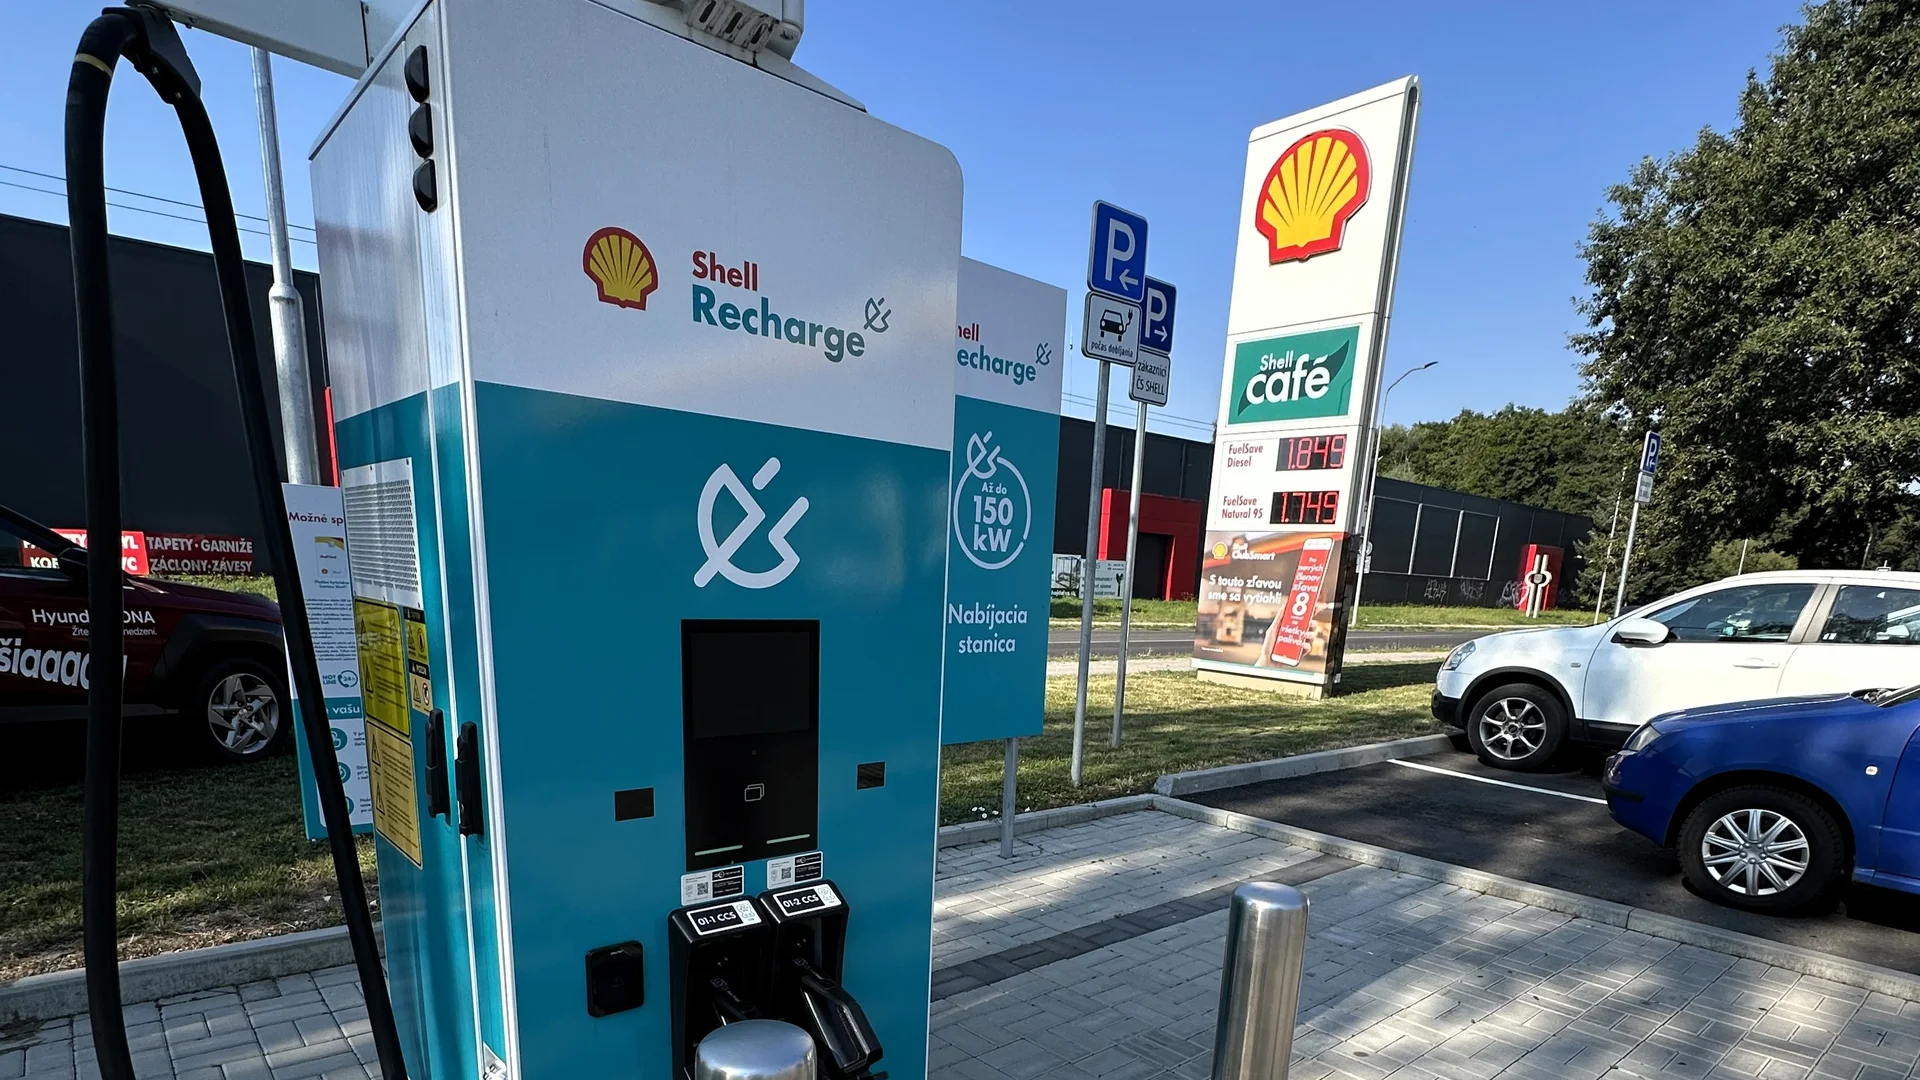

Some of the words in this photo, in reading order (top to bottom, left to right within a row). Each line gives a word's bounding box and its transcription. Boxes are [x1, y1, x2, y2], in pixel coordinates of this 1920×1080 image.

[1105, 217, 1136, 281] P
[692, 250, 758, 292] Shell
[1144, 287, 1168, 338] P
[692, 284, 865, 363] Recharge
[957, 344, 1036, 385] echarge
[1260, 350, 1294, 371] Shell
[1145, 380, 1165, 396] SHELL
[1246, 353, 1331, 405] café
[1227, 456, 1252, 468] Diesel
[1228, 443, 1264, 455] FuelSave
[1287, 435, 1346, 470] 1.849
[981, 482, 994, 493] Až
[996, 483, 1007, 495] do
[288, 511, 328, 524] Možné
[973, 495, 1014, 526] 150
[1221, 508, 1251, 519] Natural
[1253, 508, 1263, 519] 95
[1223, 495, 1257, 506] FuelSave
[1280, 491, 1340, 523] 1.749
[146, 536, 193, 551] TAPETY
[200, 538, 253, 553] GARNIŽE
[973, 524, 1012, 552] kW
[149, 555, 208, 572] ZÁCLONY
[212, 557, 253, 572] ZÁVESY
[1209, 574, 1217, 586] S
[1218, 576, 1244, 587] touto
[1207, 591, 1227, 601] sme
[1229, 592, 1241, 602] sa
[1292, 592, 1310, 616] 8
[32, 609, 89, 626] Hyund
[948, 602, 1028, 630] Nabíjacia
[958, 632, 1016, 654] stanica
[332, 703, 360, 714] vašu
[782, 897, 801, 908] 01-2
[801, 894, 820, 904] CCS
[697, 915, 716, 926] 01-1
[717, 911, 737, 922] CCS
